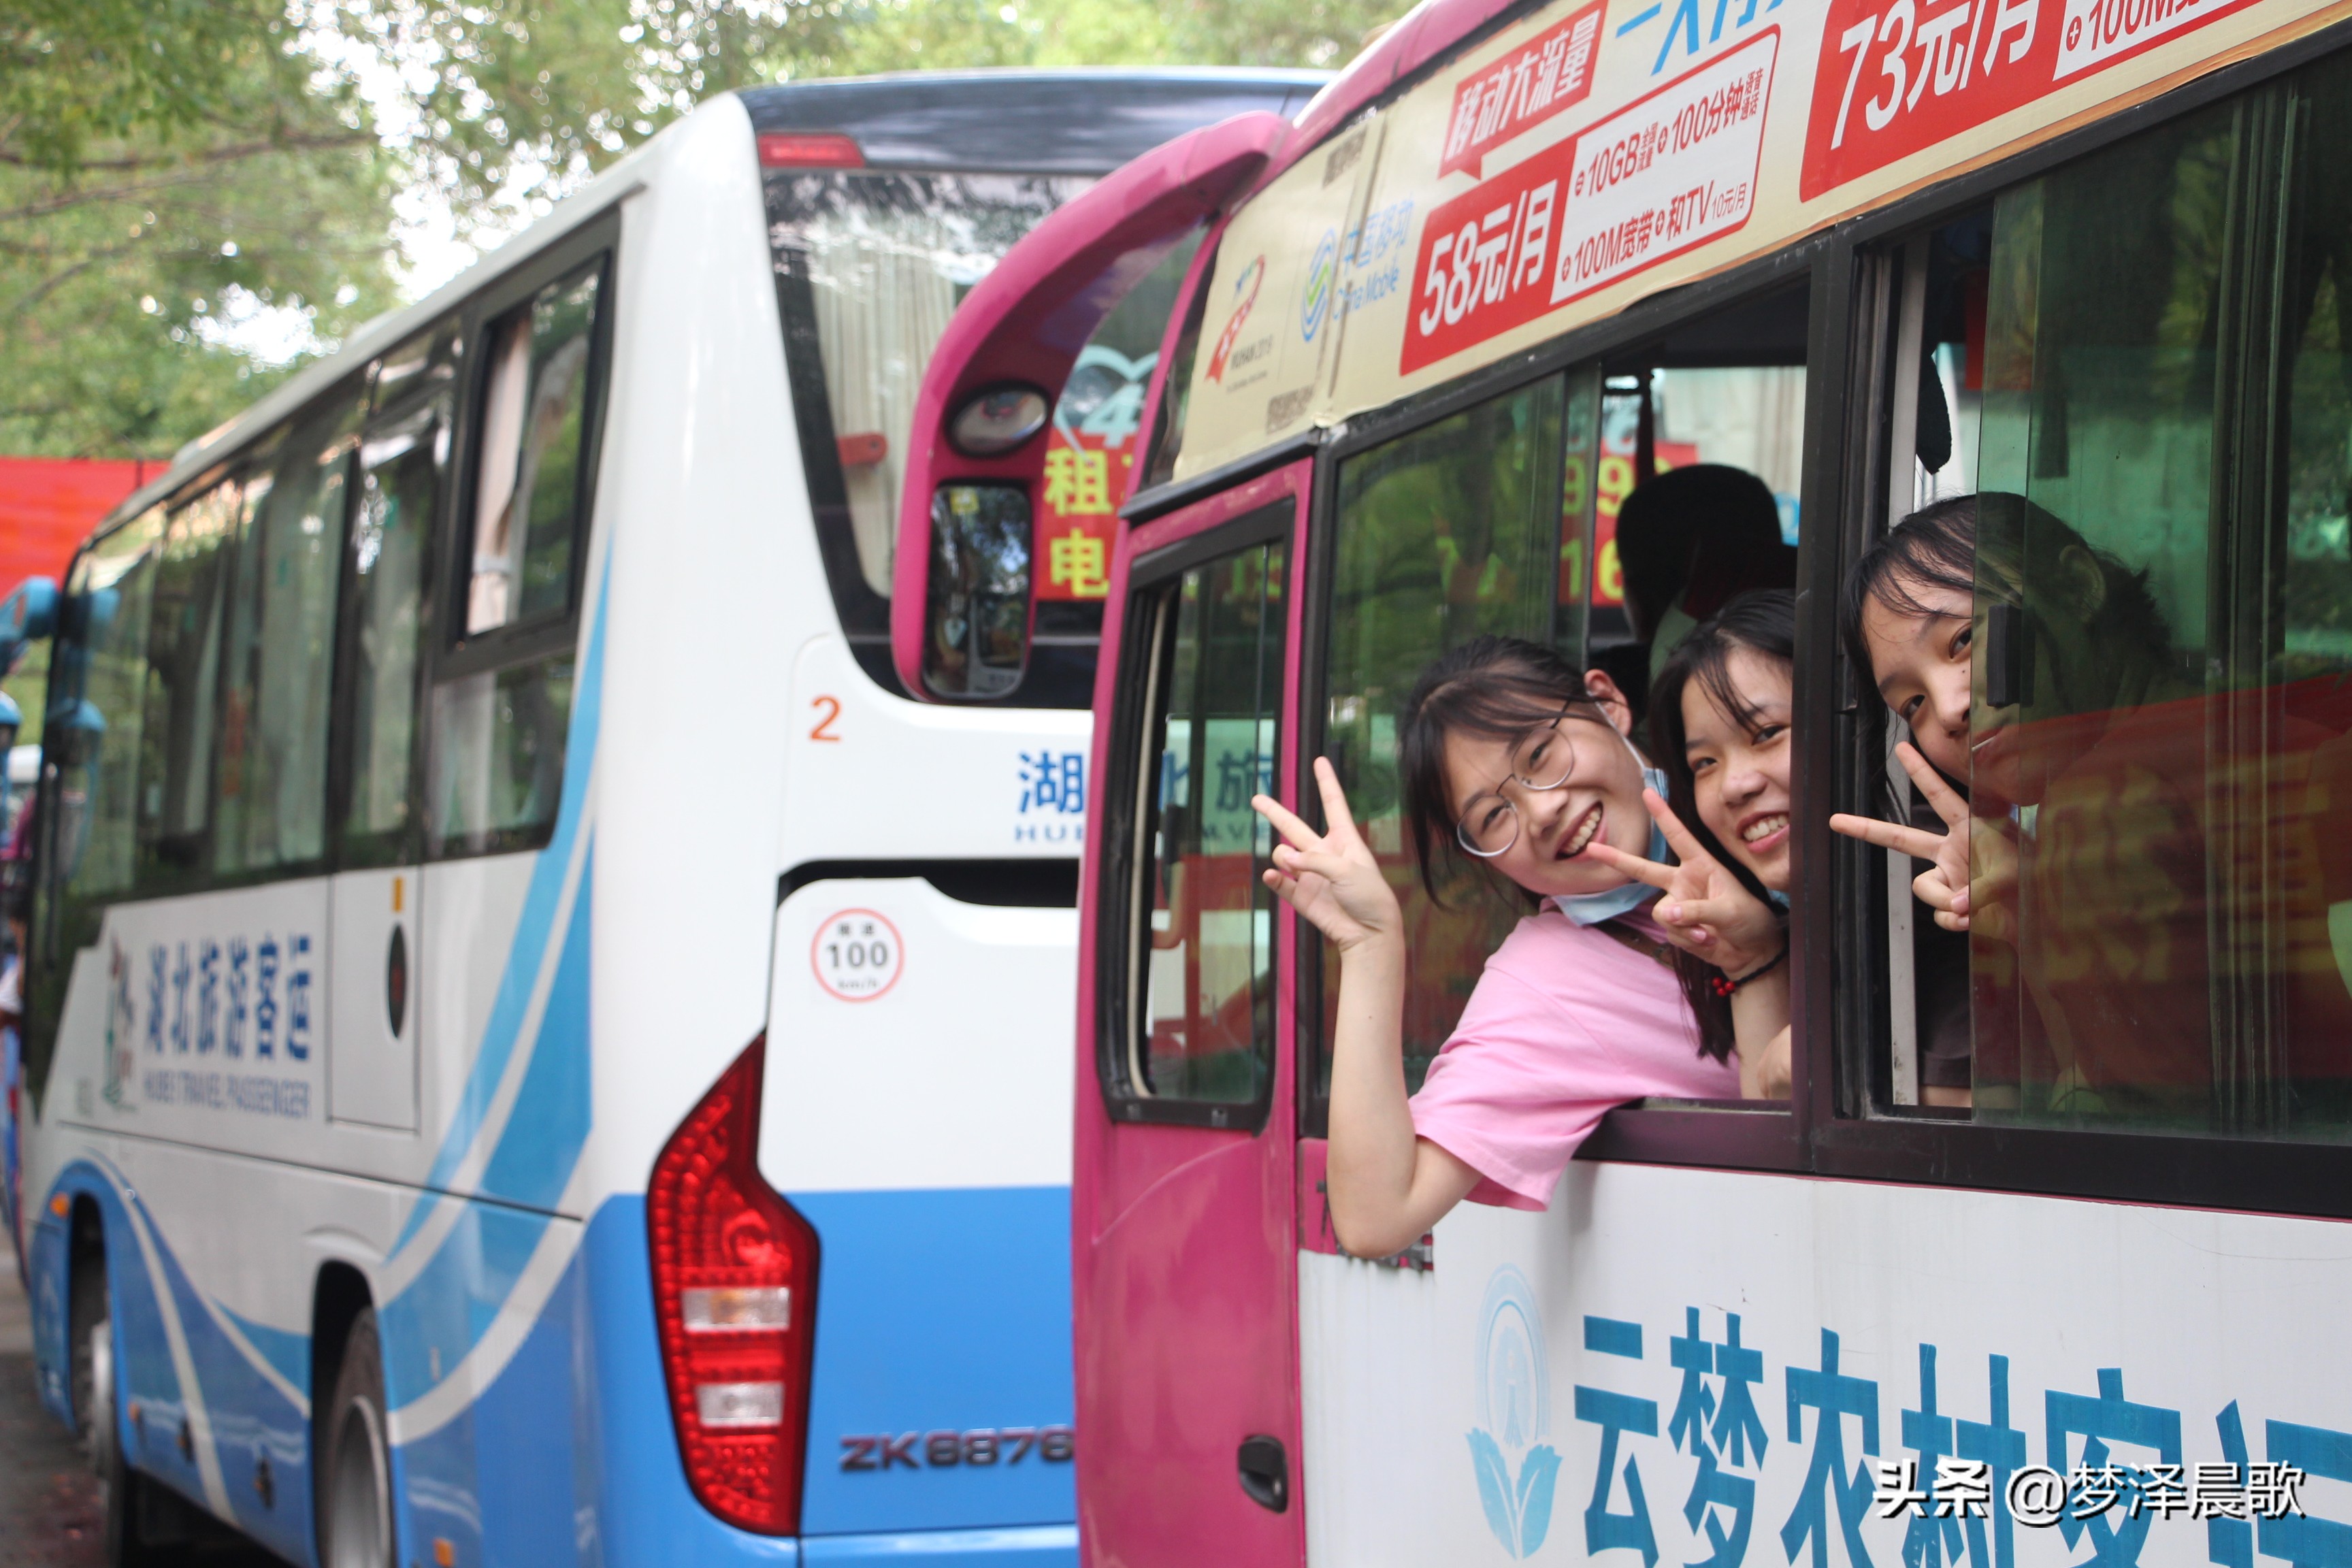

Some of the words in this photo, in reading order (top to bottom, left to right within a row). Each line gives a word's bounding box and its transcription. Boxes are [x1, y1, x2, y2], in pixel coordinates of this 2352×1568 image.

[1444, 8, 1601, 162] 移动大流量
[1830, 0, 2037, 150] 73元/月
[1588, 132, 1640, 196] 10GB
[1671, 78, 1746, 154] 100分钟
[1418, 178, 1558, 337] 58元/月
[1575, 208, 1654, 283] 100M宽带
[1667, 179, 1714, 241] 和TV
[1712, 182, 1747, 219] 10元/月
[811, 696, 842, 742] 2
[826, 941, 887, 968] 100
